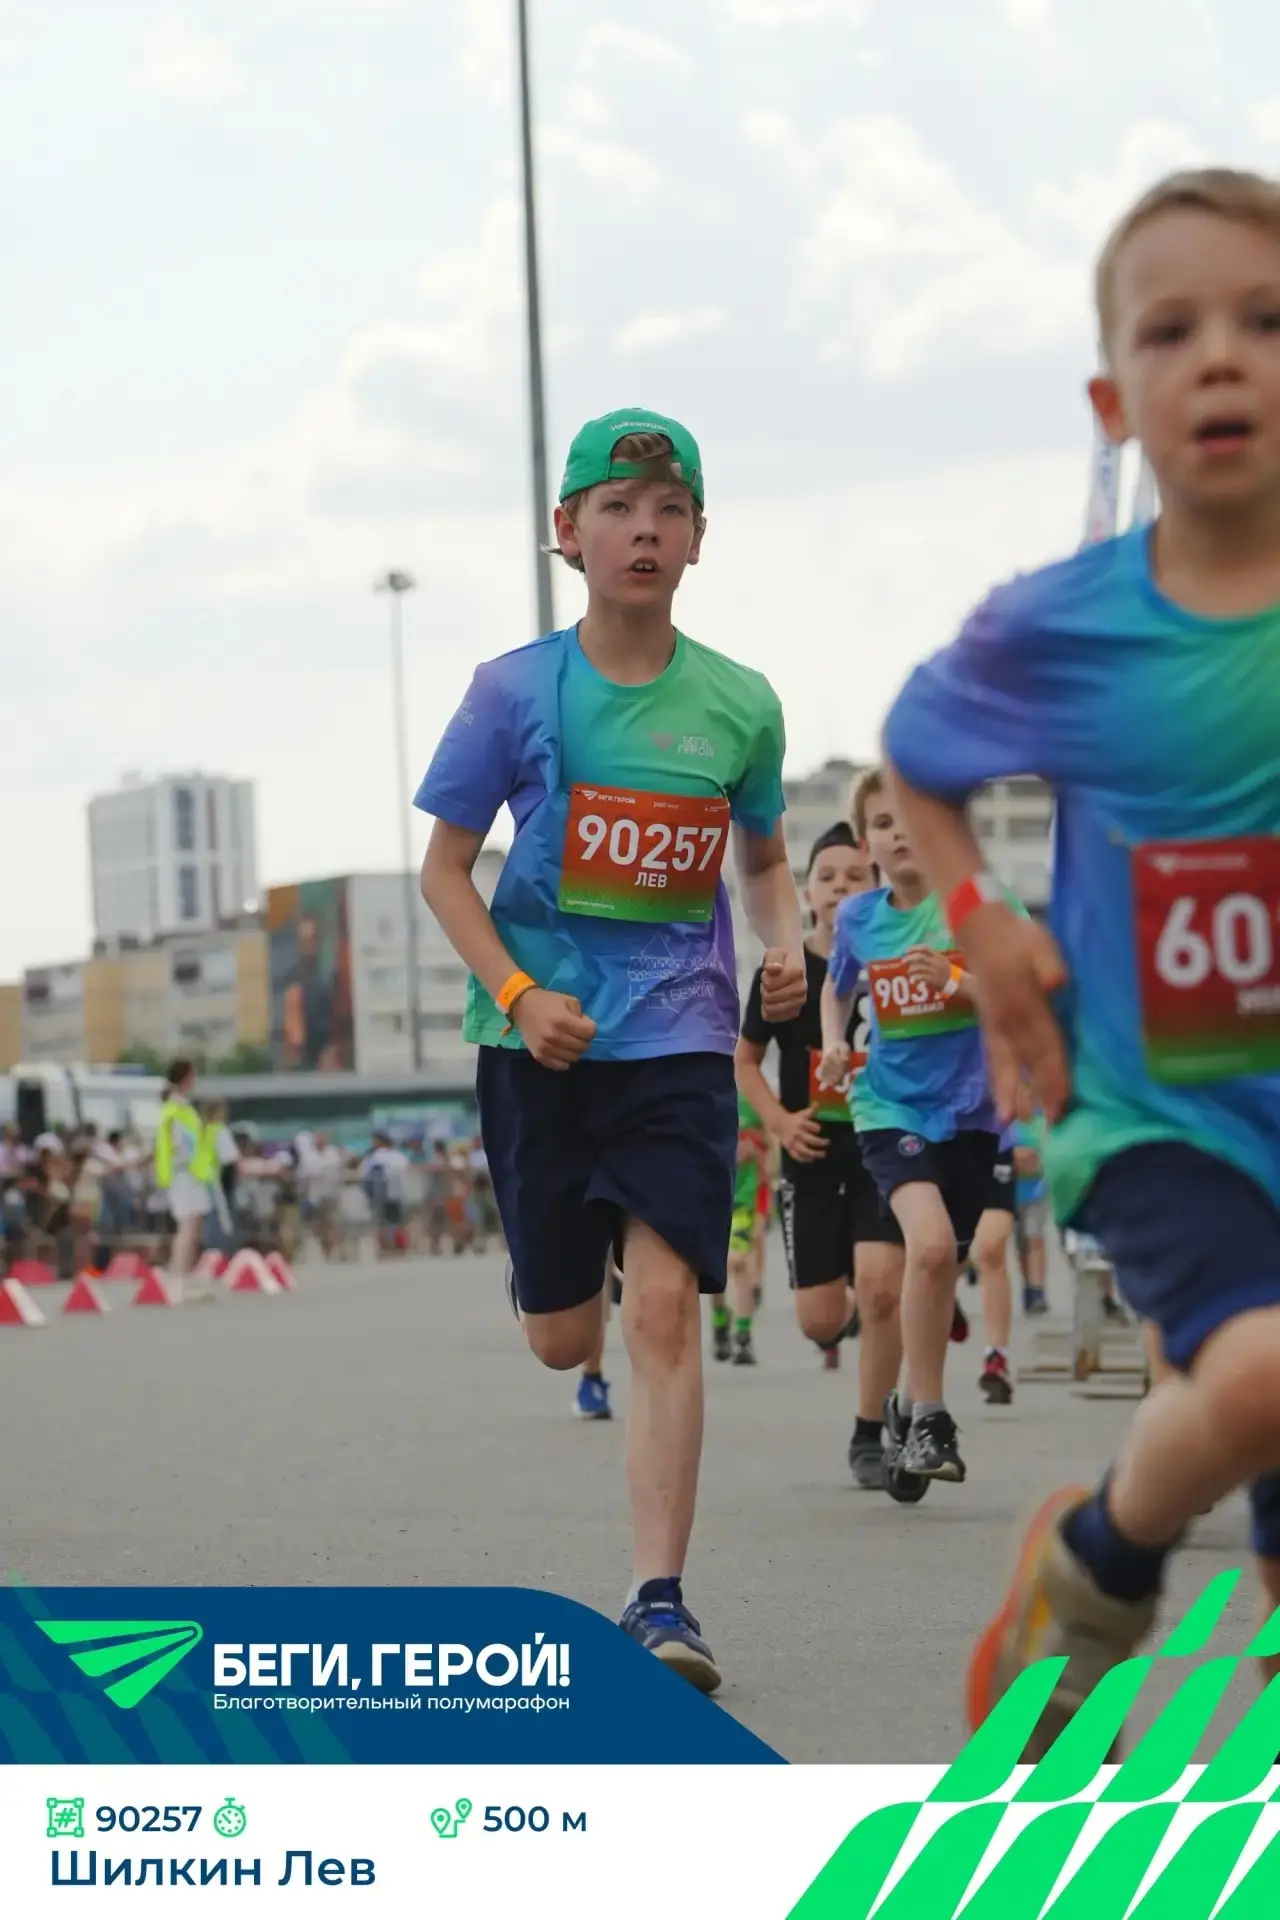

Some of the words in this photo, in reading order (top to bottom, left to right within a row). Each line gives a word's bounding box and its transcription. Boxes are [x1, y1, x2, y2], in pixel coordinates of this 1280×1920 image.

[610, 421, 671, 433] Volkswagen
[577, 814, 723, 872] 90257
[634, 871, 668, 888] ЛЕВ
[1156, 893, 1280, 988] 60
